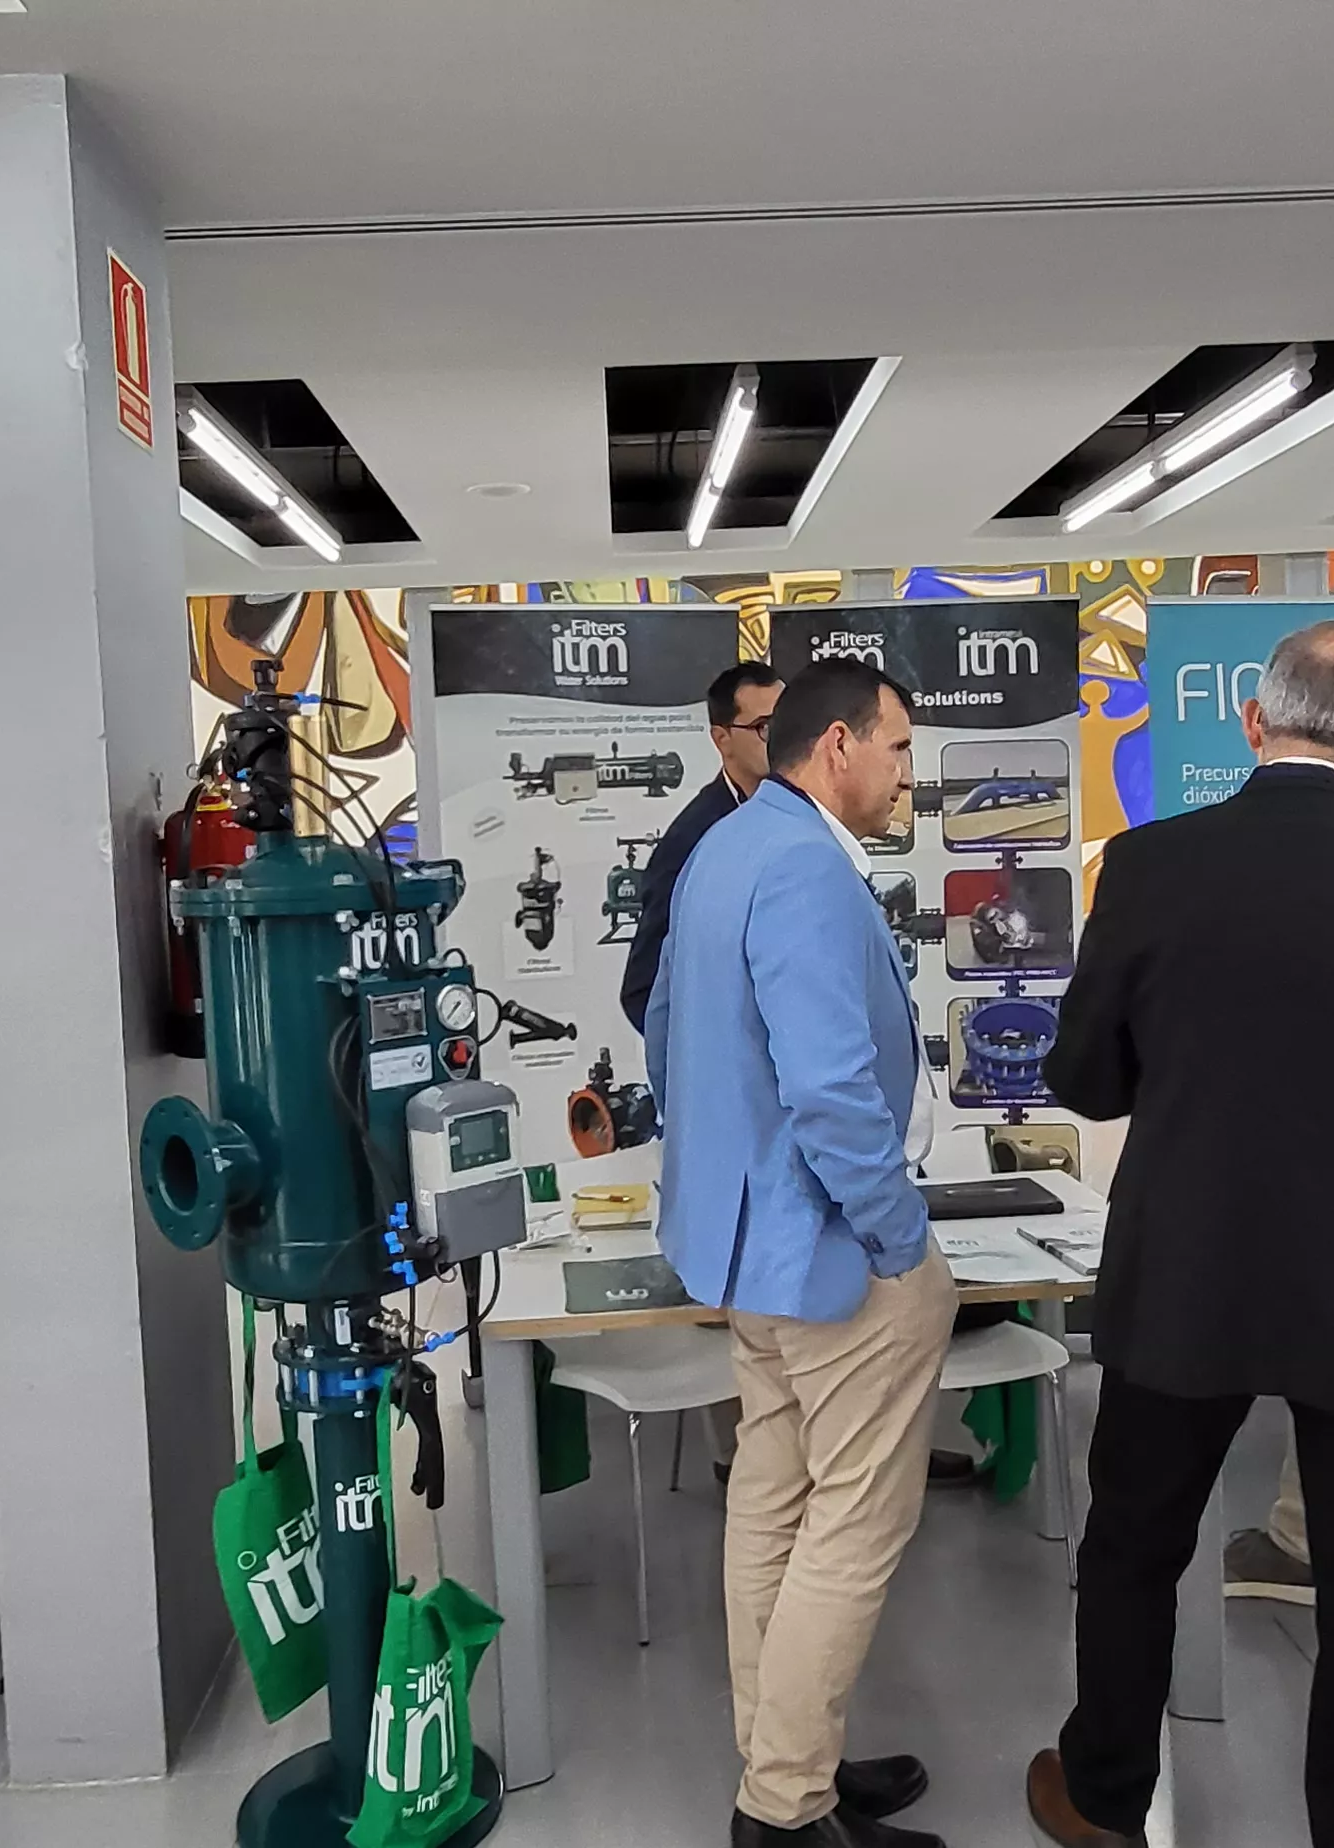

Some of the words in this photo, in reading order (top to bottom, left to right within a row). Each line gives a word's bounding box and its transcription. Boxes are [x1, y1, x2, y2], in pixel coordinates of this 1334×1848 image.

[571, 619, 627, 636] Filters
[551, 623, 628, 673] itm
[830, 631, 884, 647] Filters
[958, 626, 1038, 677] itm
[911, 689, 1004, 707] Solutions
[1181, 763, 1253, 782] Precurs
